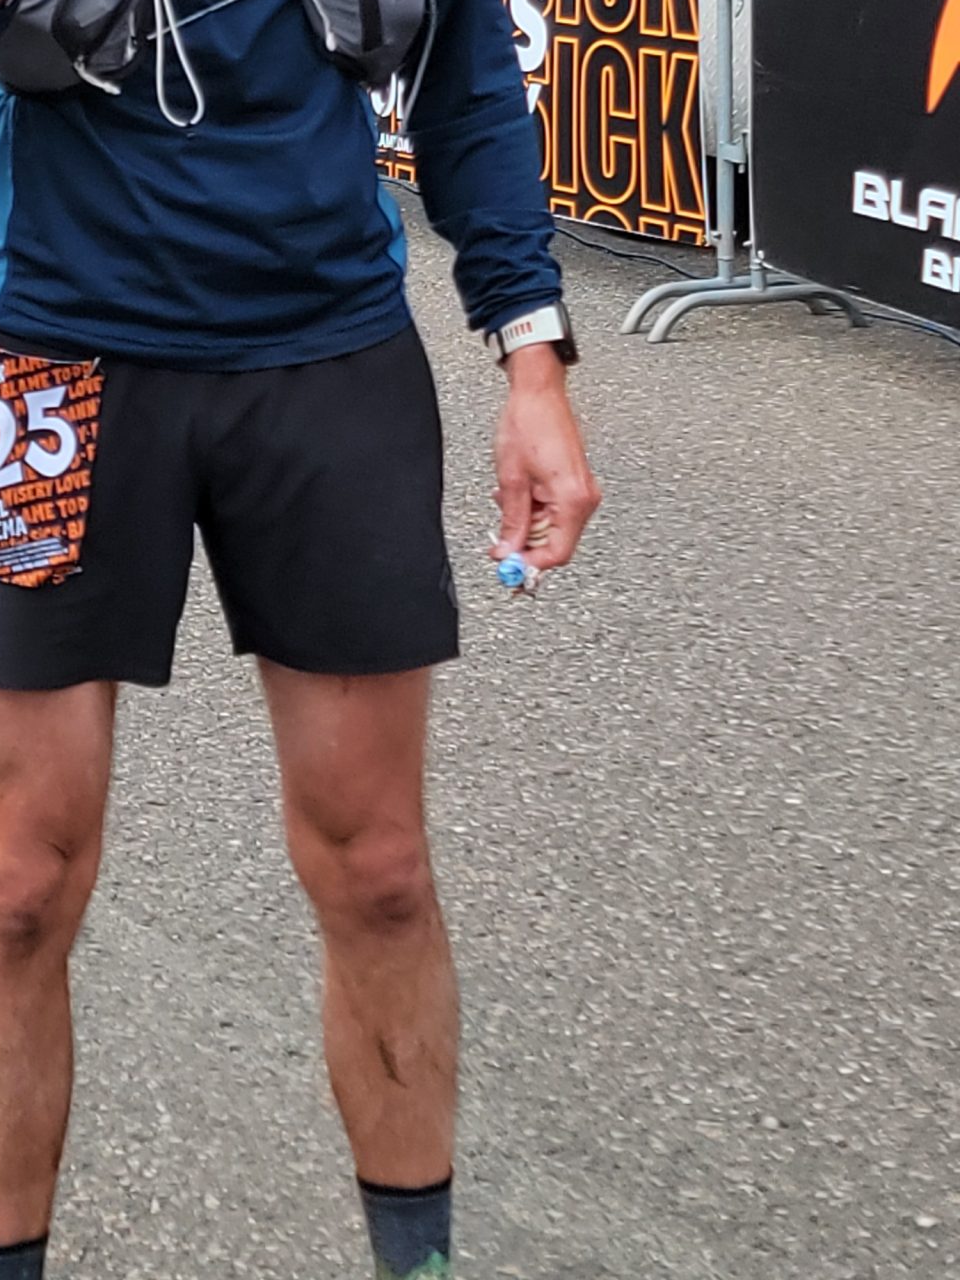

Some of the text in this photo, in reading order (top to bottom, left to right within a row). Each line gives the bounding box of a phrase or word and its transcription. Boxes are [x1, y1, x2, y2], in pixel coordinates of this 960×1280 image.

[852, 170, 960, 241] BLA
[0, 372, 52, 399] BLAME
[68, 376, 105, 399] LOVE
[1, 471, 91, 506] MISERY LOVE
